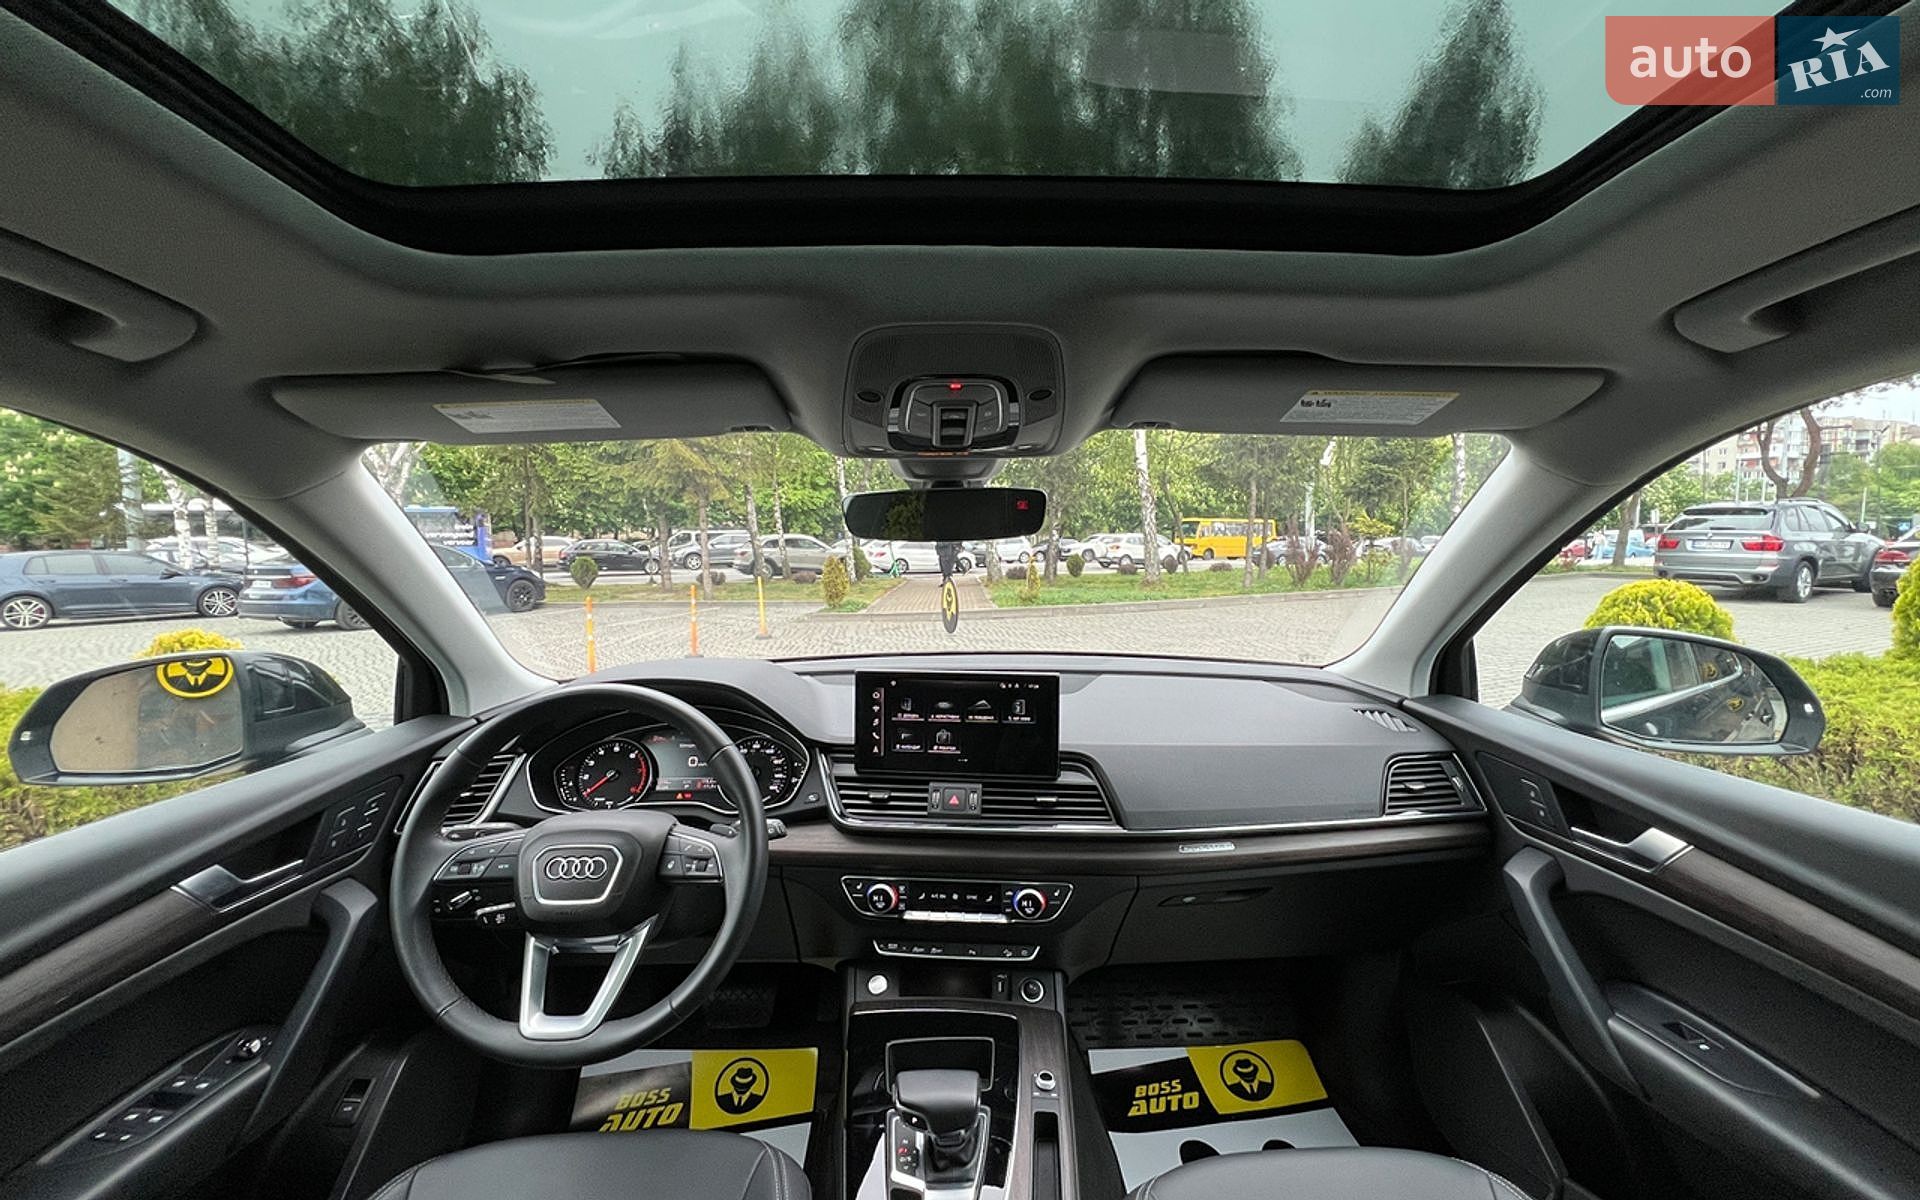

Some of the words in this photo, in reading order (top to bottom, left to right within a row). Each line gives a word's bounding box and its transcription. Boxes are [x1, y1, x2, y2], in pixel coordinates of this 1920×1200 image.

[614, 1087, 672, 1110] BOSS
[1134, 1079, 1182, 1098] BOSS
[1127, 1091, 1200, 1117] AUTO
[598, 1102, 684, 1132] AUTO
